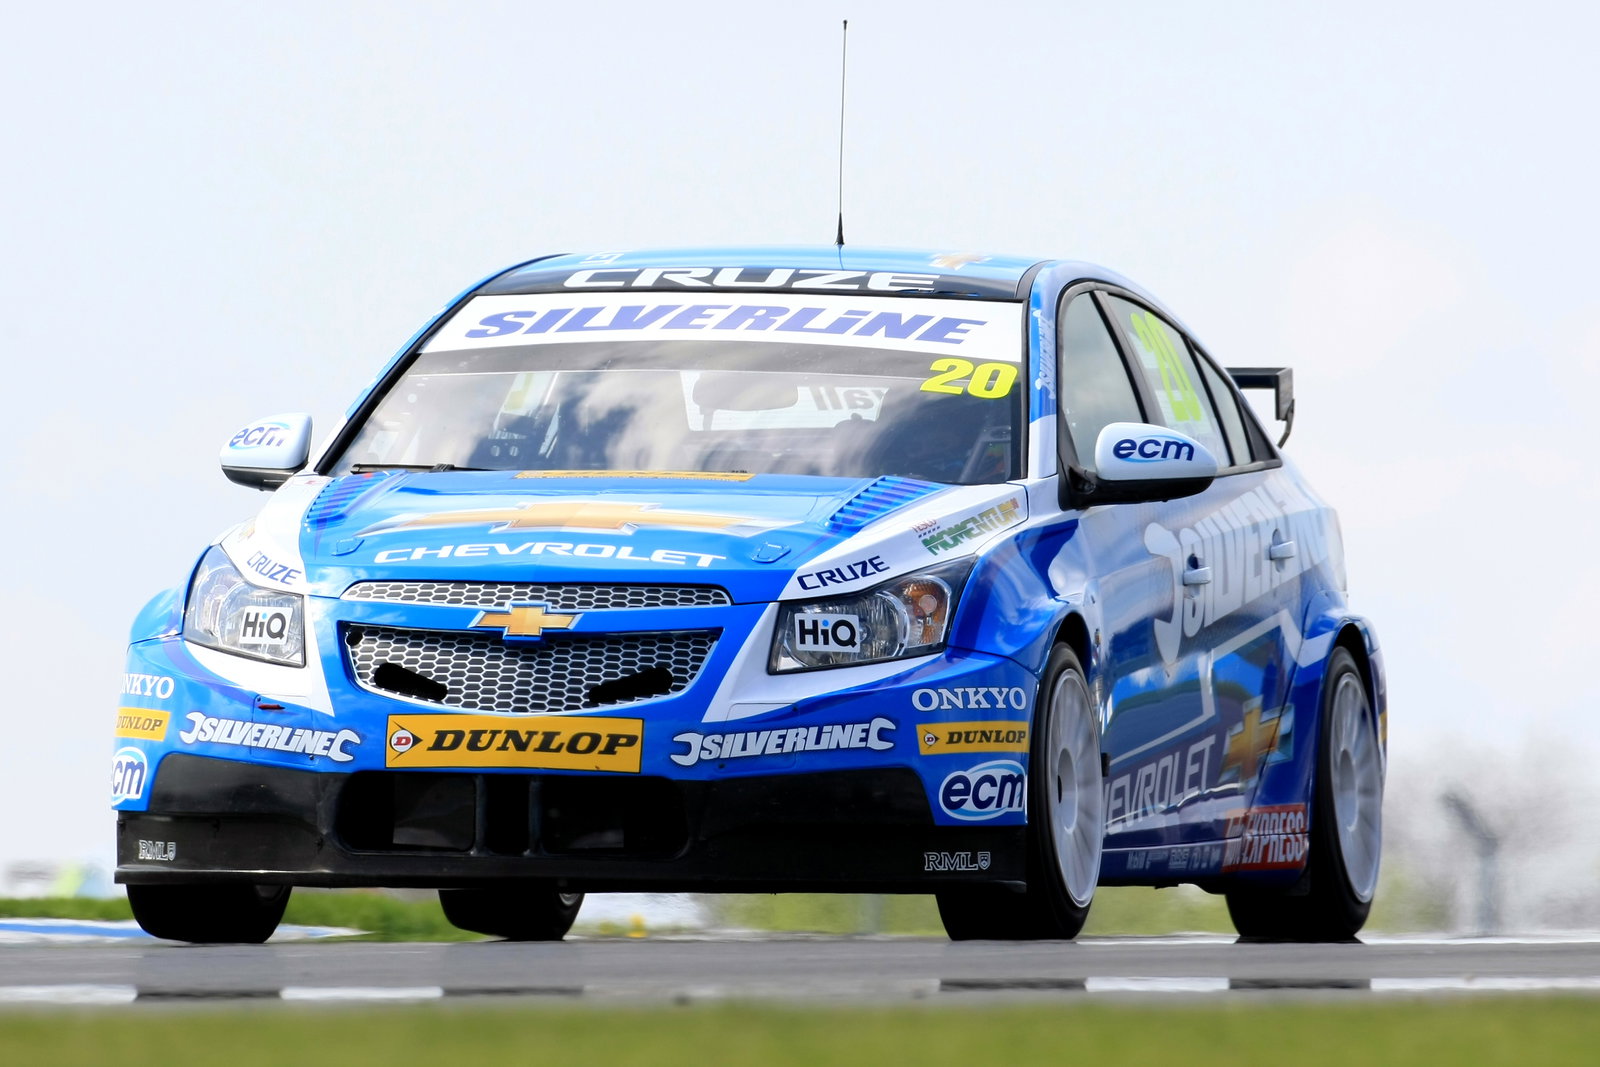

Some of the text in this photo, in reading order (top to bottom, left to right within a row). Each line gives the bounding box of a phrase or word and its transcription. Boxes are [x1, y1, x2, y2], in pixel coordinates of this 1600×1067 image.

[563, 267, 941, 292] CRUZE
[920, 358, 1018, 399] 20
[228, 424, 285, 449] ecm
[1112, 438, 1195, 462] ecm
[921, 502, 1020, 557] MOMENTUM
[246, 550, 302, 586] CRUZE
[373, 542, 727, 568] CHEVROLET
[797, 555, 890, 591] CRUZE
[798, 619, 858, 649] HiQ
[120, 673, 175, 700] NKYO
[911, 686, 1027, 712] ONKYO
[116, 715, 163, 732] DUNLOP
[946, 729, 1026, 745] DUNLOP
[427, 729, 640, 756] DUNLOP
[112, 760, 146, 796] cm
[942, 773, 1025, 810] ecm
[1241, 810, 1305, 864] EXPRESS
[924, 851, 980, 871] RML
